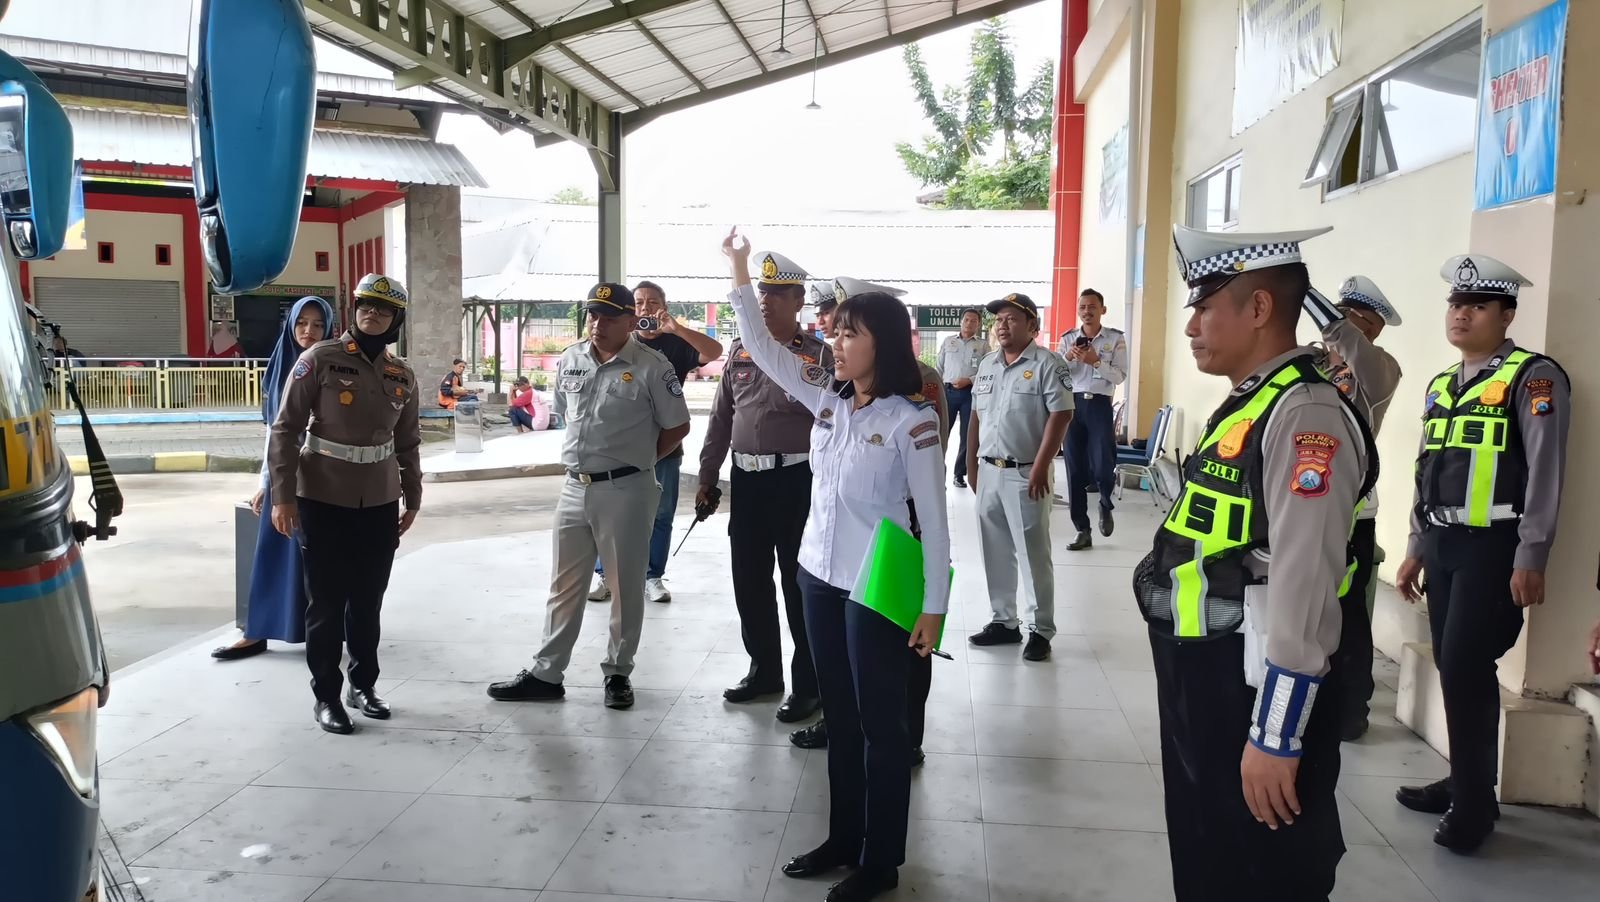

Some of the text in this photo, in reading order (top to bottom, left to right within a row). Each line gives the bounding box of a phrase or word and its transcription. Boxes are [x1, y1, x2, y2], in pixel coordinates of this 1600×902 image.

[929, 308, 961, 317] TOILET
[930, 317, 961, 326] UMUM
[1472, 406, 1504, 415] POLRI
[1295, 434, 1335, 447] POLRES
[1201, 461, 1238, 481] POLRI
